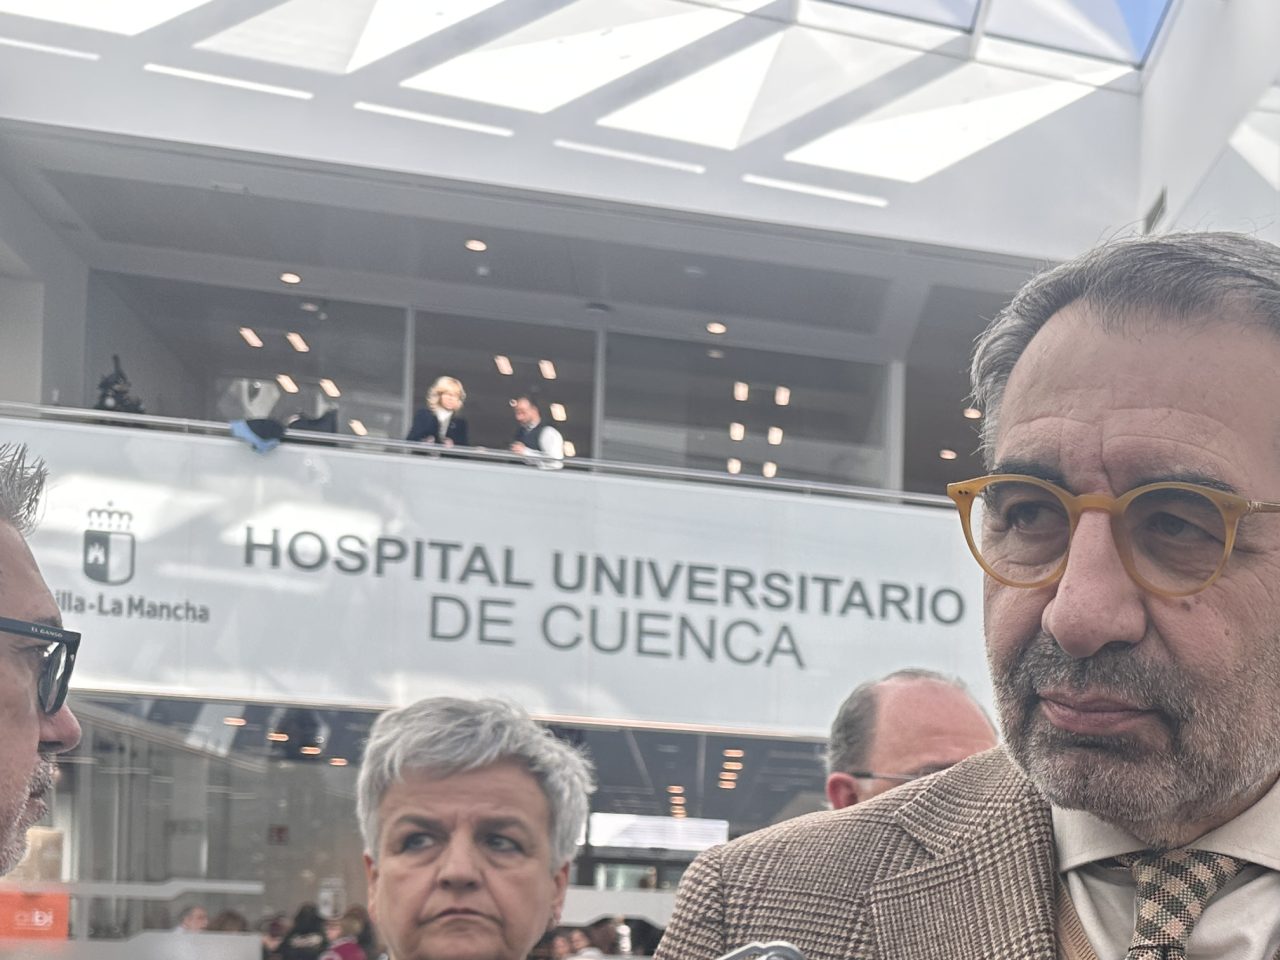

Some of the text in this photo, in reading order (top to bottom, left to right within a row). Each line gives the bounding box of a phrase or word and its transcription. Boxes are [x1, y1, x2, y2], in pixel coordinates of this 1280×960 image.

[127, 596, 210, 623] Mancha
[244, 526, 966, 626] HOSPITAL UNIVERSITARIO
[428, 595, 807, 671] DE CUENCA
